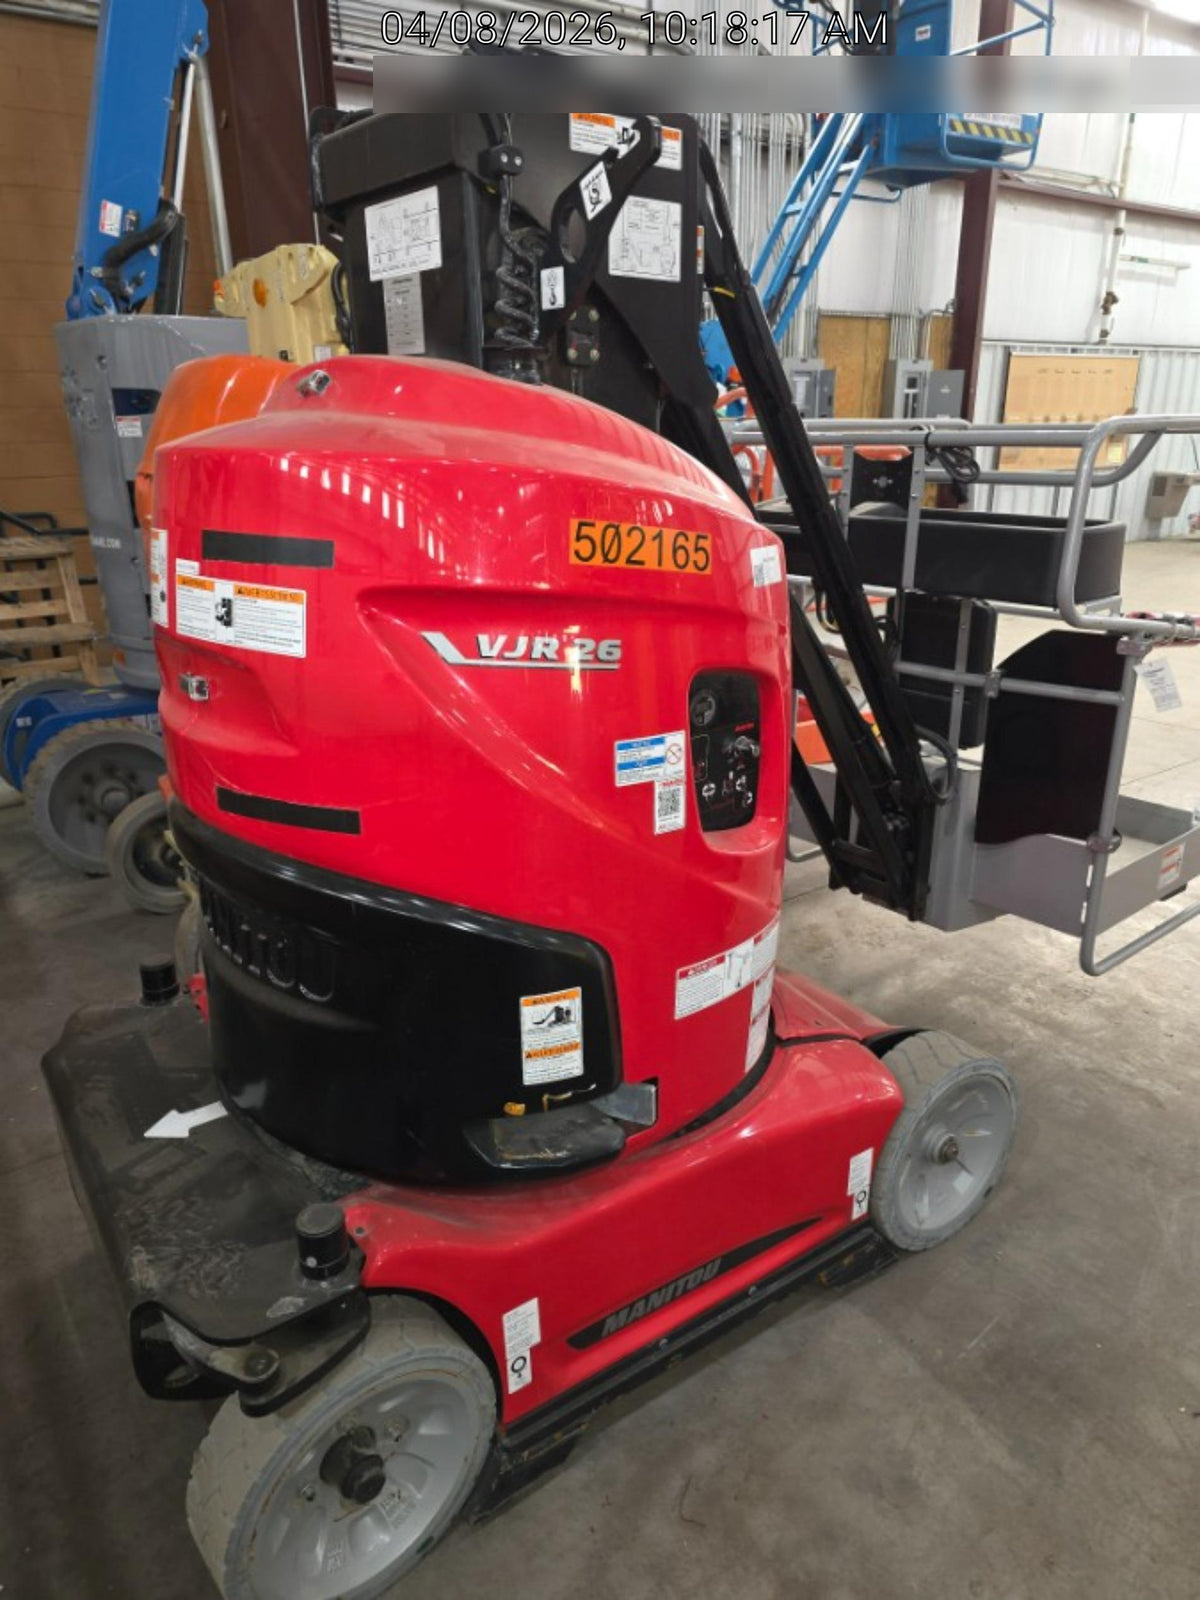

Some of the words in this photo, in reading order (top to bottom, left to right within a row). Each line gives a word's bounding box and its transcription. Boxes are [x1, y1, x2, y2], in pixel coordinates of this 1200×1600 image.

[574, 521, 710, 571] 502165
[477, 634, 560, 660] VJR
[572, 637, 622, 661] 26
[601, 1257, 721, 1337] MANITOU
